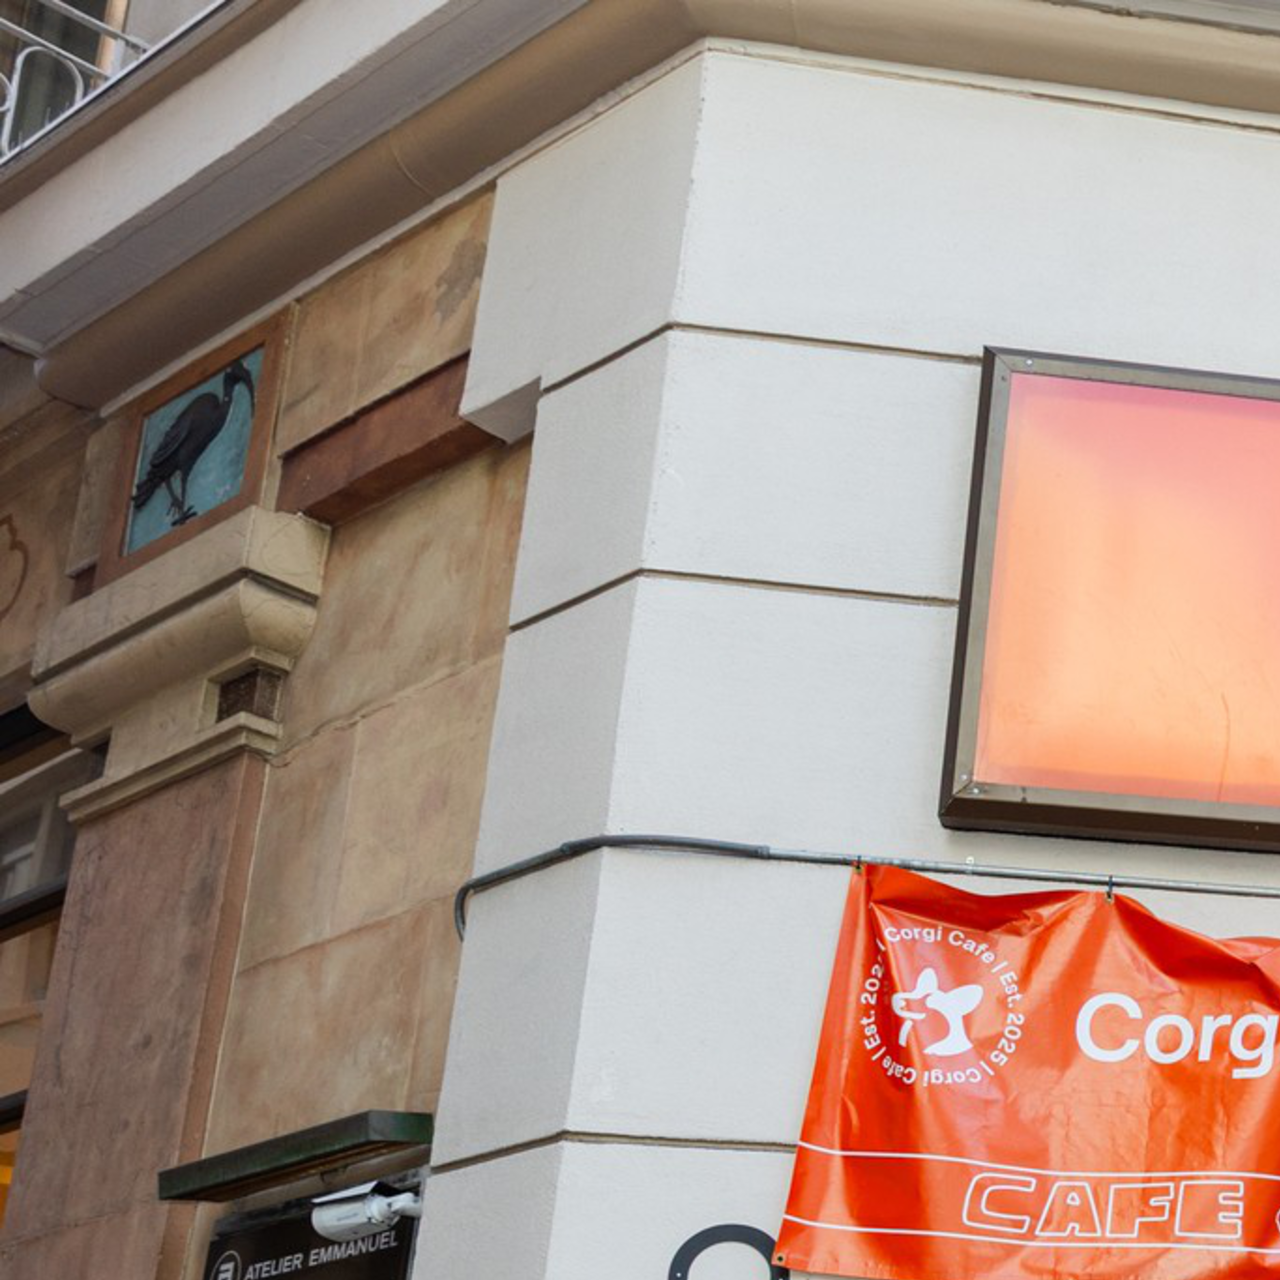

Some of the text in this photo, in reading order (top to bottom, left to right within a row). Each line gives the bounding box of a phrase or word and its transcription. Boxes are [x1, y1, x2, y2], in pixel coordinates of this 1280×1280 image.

[883, 926, 943, 943] Corgi
[948, 931, 995, 964] Cafe
[999, 971, 1023, 1009] Est.
[990, 1014, 1025, 1066] 2025
[882, 1056, 917, 1084] Cafe
[922, 1067, 982, 1087] Corgi
[962, 1172, 1244, 1239] CAFE
[308, 1230, 398, 1267] EMMANUEL
